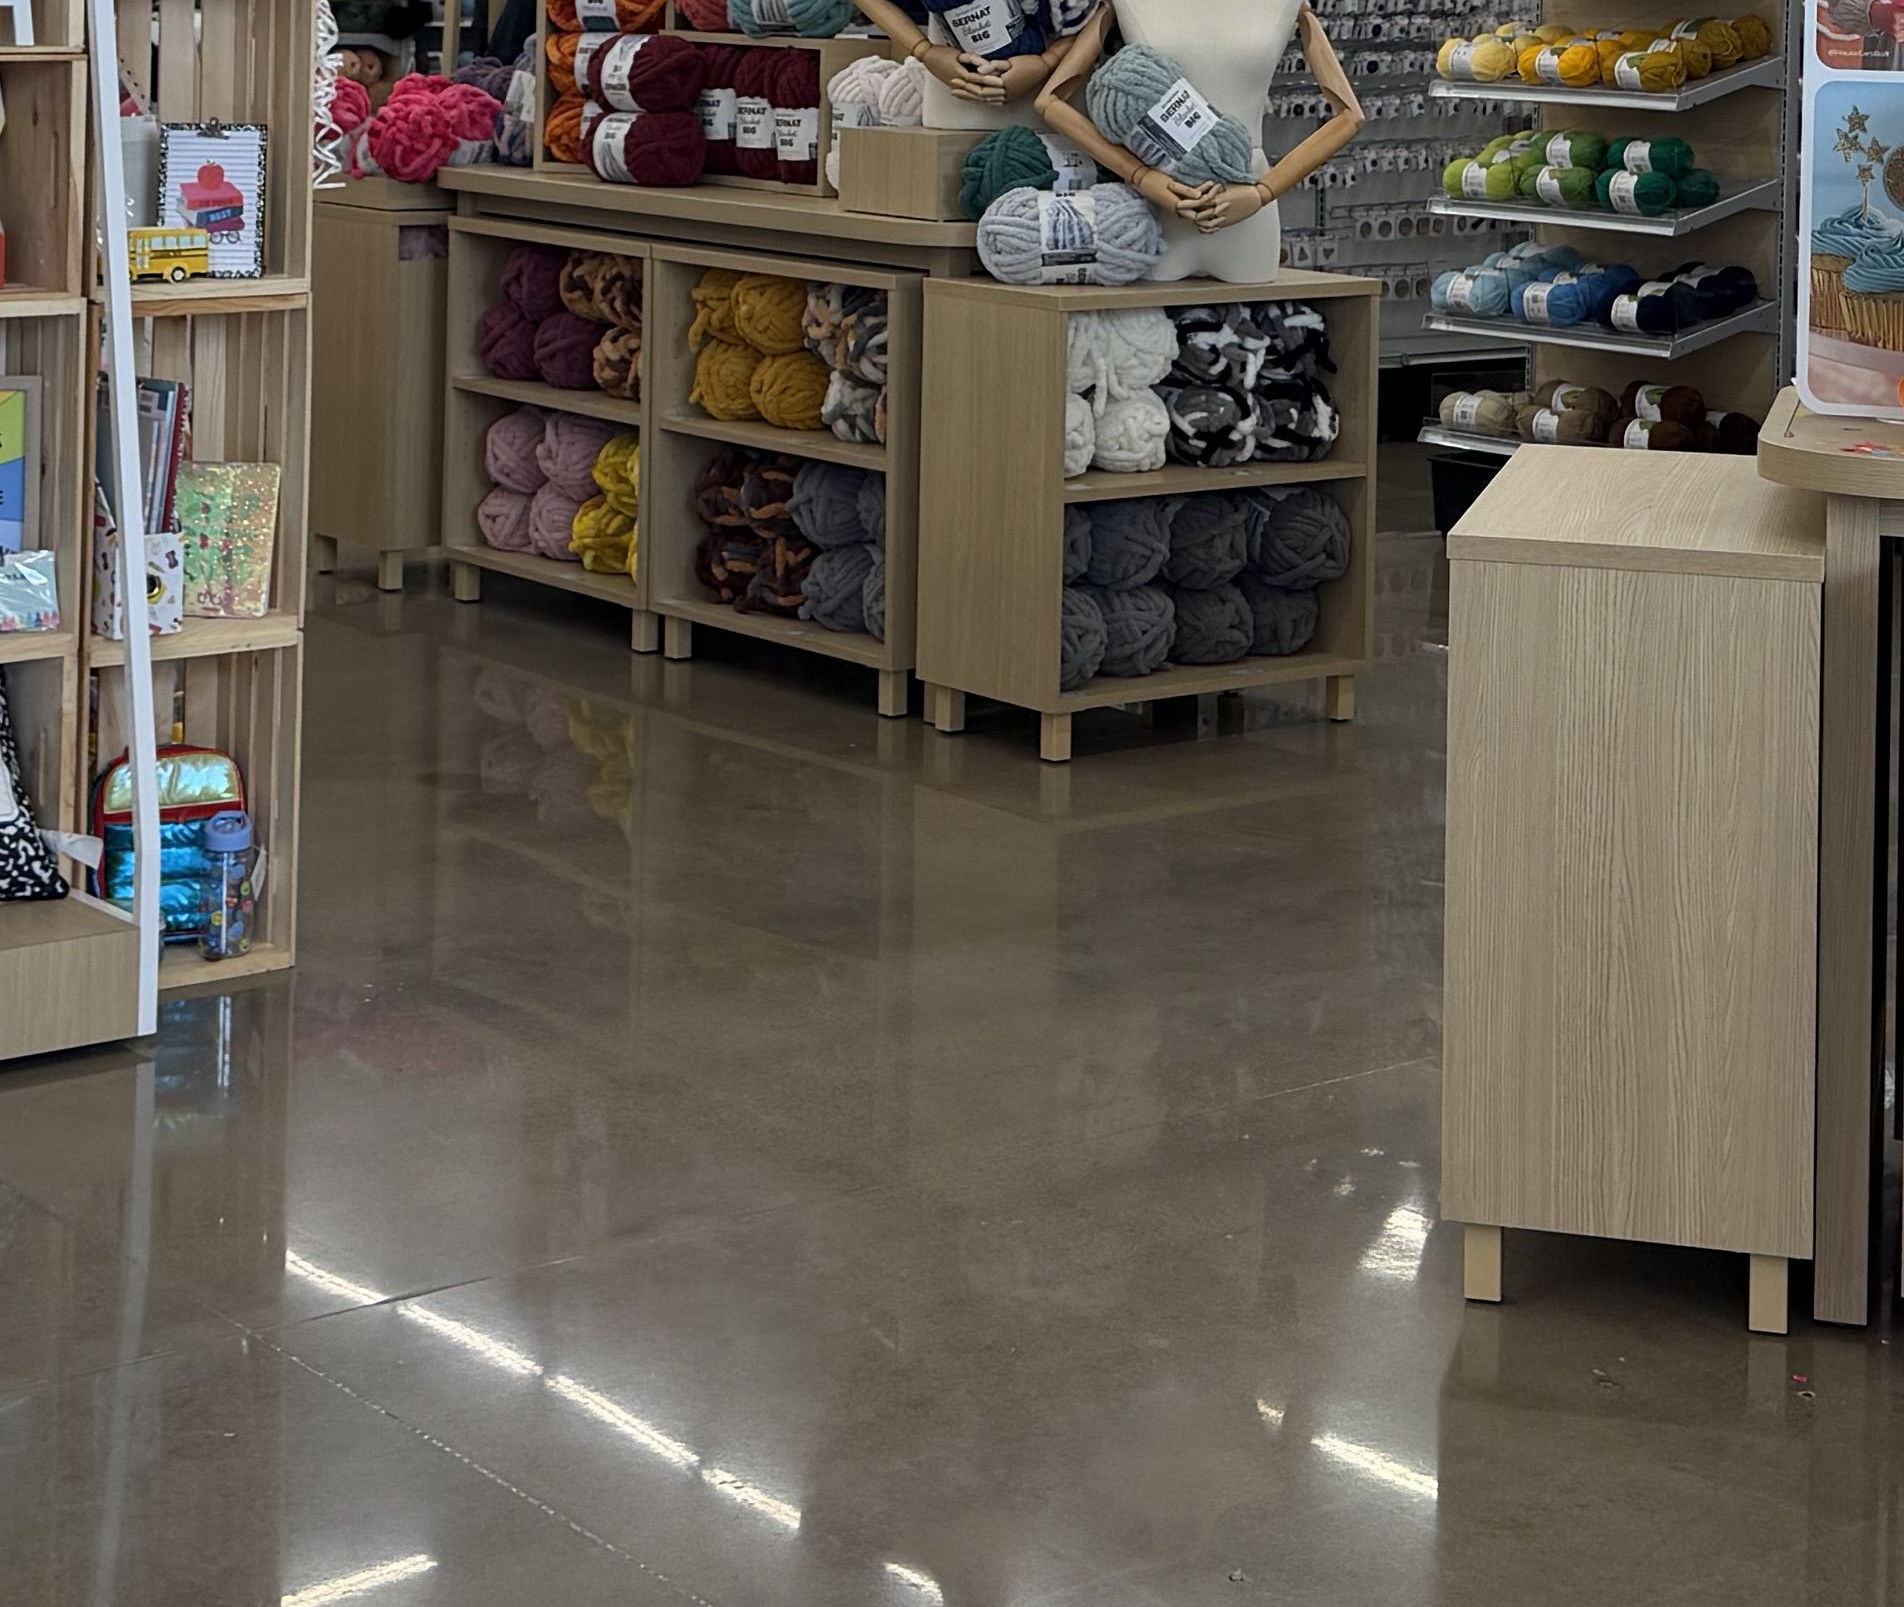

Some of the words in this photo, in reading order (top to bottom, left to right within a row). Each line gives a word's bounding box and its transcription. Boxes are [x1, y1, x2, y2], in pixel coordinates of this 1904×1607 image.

[951, 6, 992, 29] BERNAT
[971, 30, 991, 45] BIG
[737, 106, 767, 116] BERNAT
[1159, 89, 1190, 123] BERNAT
[1184, 110, 1202, 129] BIG
